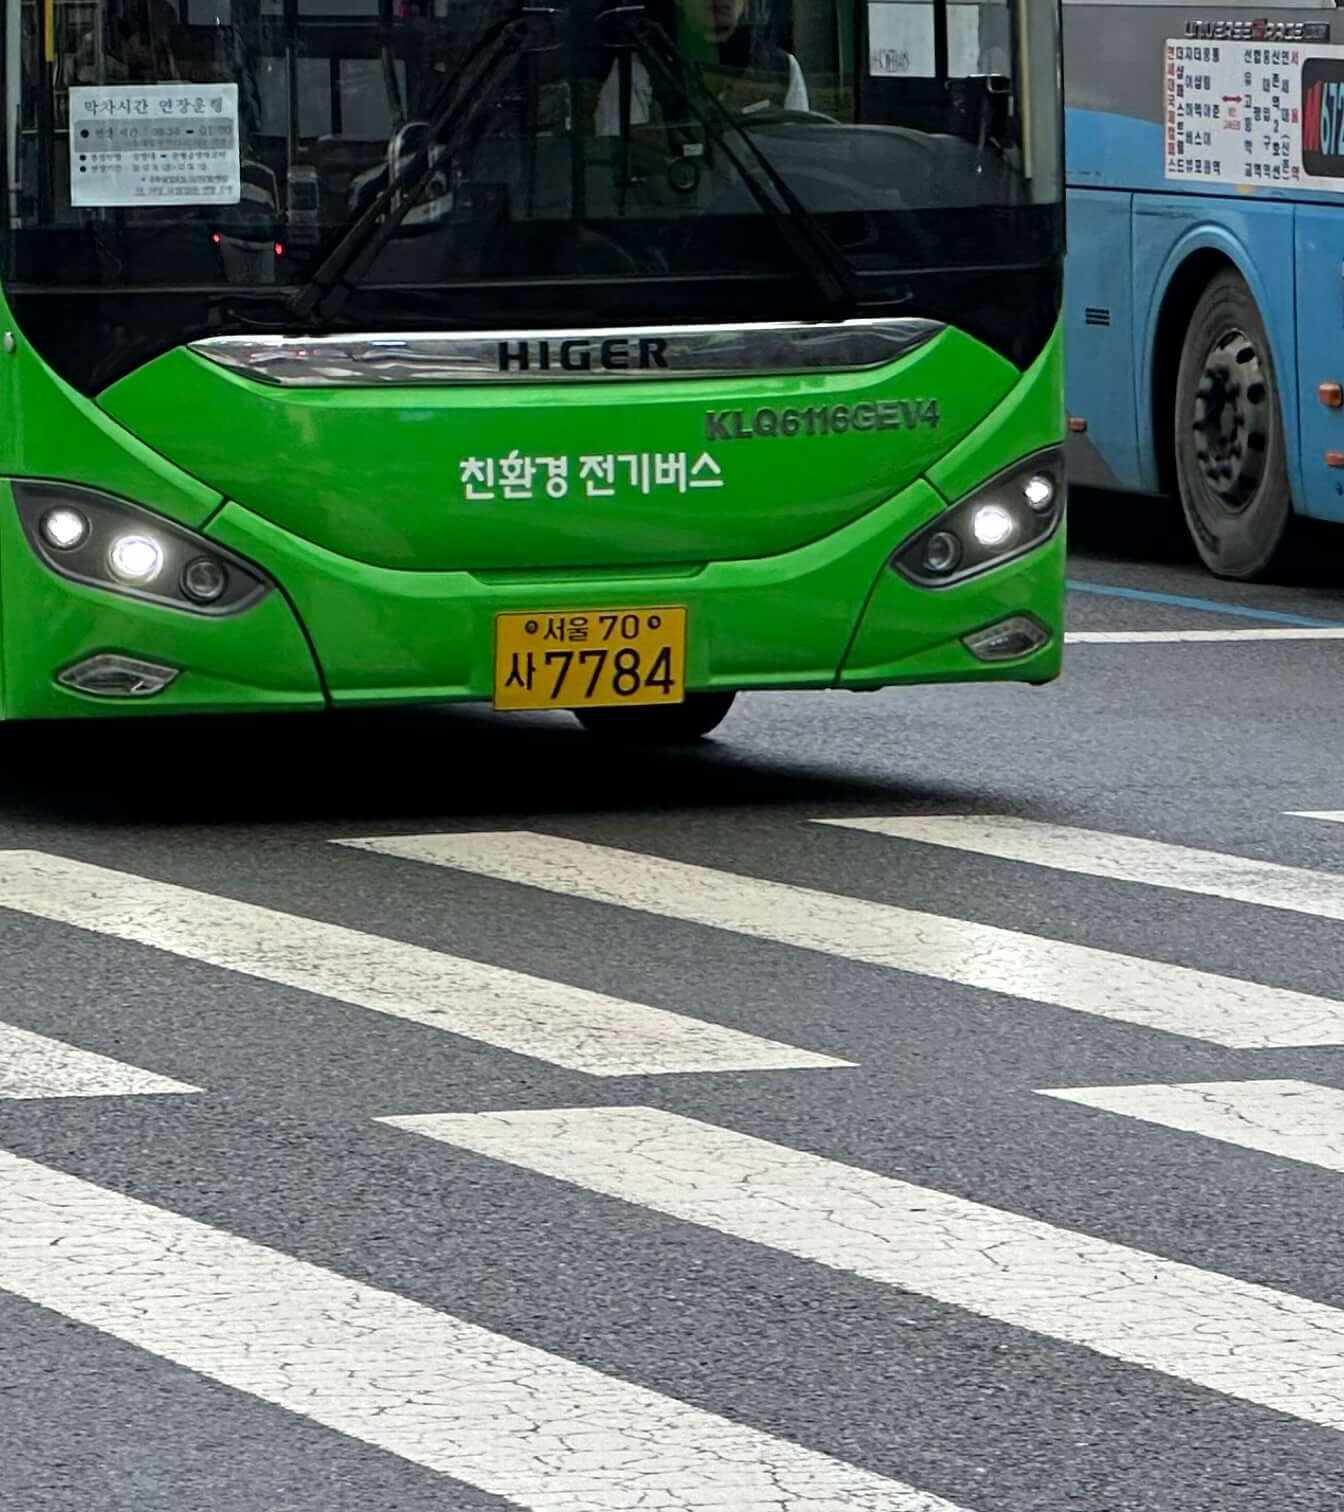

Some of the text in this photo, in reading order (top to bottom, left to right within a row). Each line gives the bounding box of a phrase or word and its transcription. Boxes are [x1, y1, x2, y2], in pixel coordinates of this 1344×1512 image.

[497, 337, 670, 372] HIGER
[704, 398, 941, 441] KLQ6116GEV4
[459, 448, 725, 501] 친환경 전기버스
[544, 614, 639, 642] 서울 70
